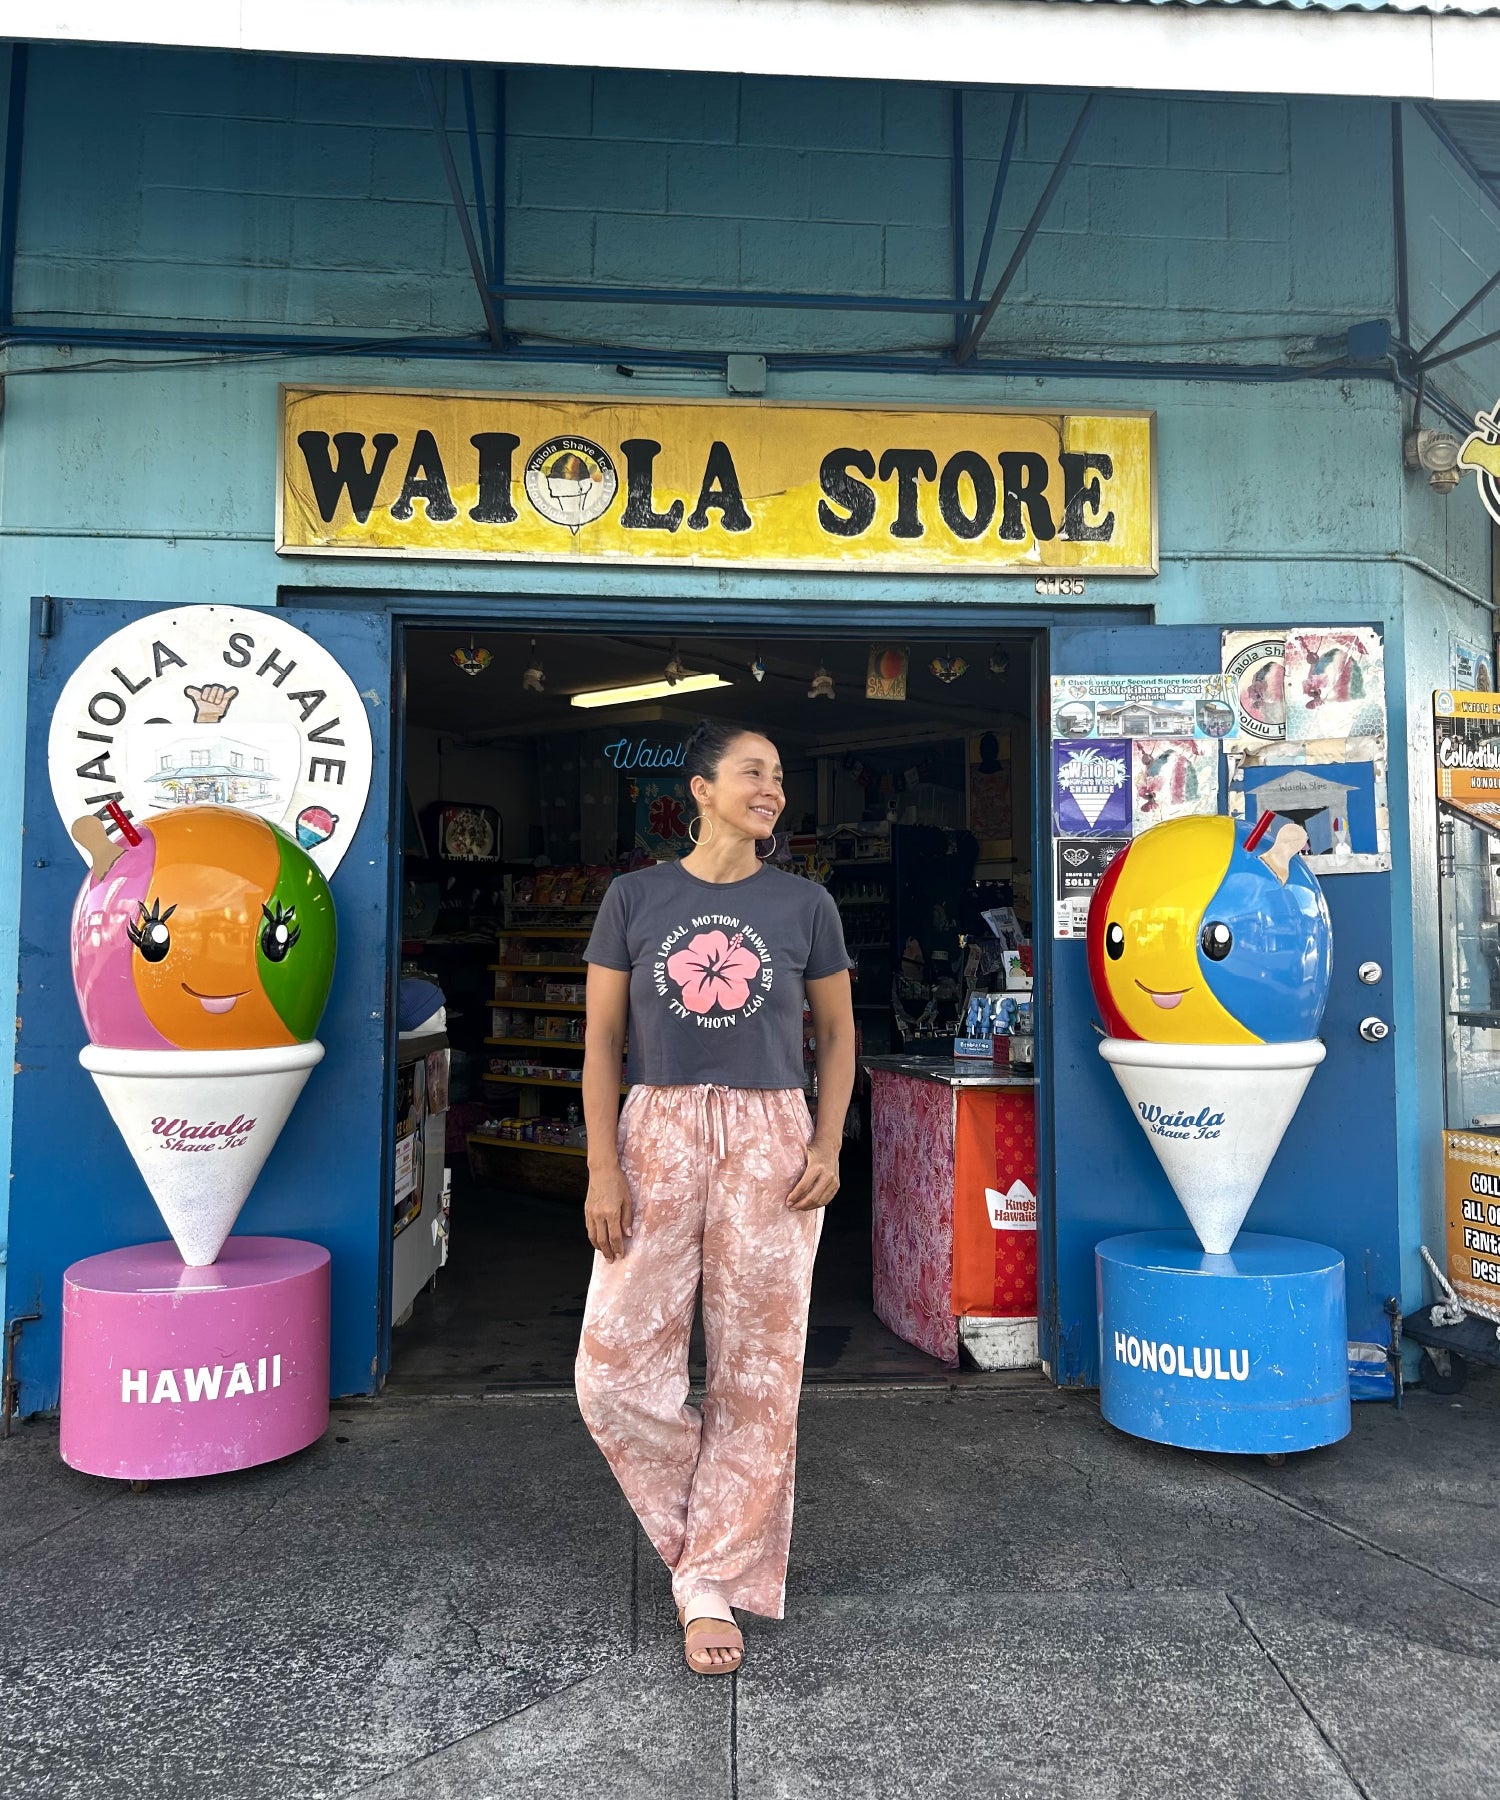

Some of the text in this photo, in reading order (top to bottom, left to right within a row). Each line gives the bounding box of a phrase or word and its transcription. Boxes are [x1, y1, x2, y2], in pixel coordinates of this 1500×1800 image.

[531, 440, 609, 473] Waiola Shave Ice
[817, 447, 1115, 542] STORE
[1111, 685, 1166, 695] Mokihana
[1166, 684, 1202, 694] Street
[222, 632, 347, 785] SHAVE
[1069, 761, 1115, 778] Waiola
[1069, 785, 1115, 793] SHAVE ICE
[1471, 777, 1500, 788] HONOL
[1064, 878, 1091, 886] SOLD
[653, 914, 773, 1029] LOCAL MOTION HAWAII EST 1977 ALOHA ALL WAYS
[1138, 1101, 1226, 1127] Waiola
[151, 1113, 258, 1139] Waiola
[1150, 1123, 1221, 1140] Shave Ice
[160, 1134, 248, 1152] Shave Ice
[1005, 1198, 1036, 1211] King's
[1114, 1331, 1249, 1381] HONOLULU
[121, 1353, 281, 1404] HAWAII
